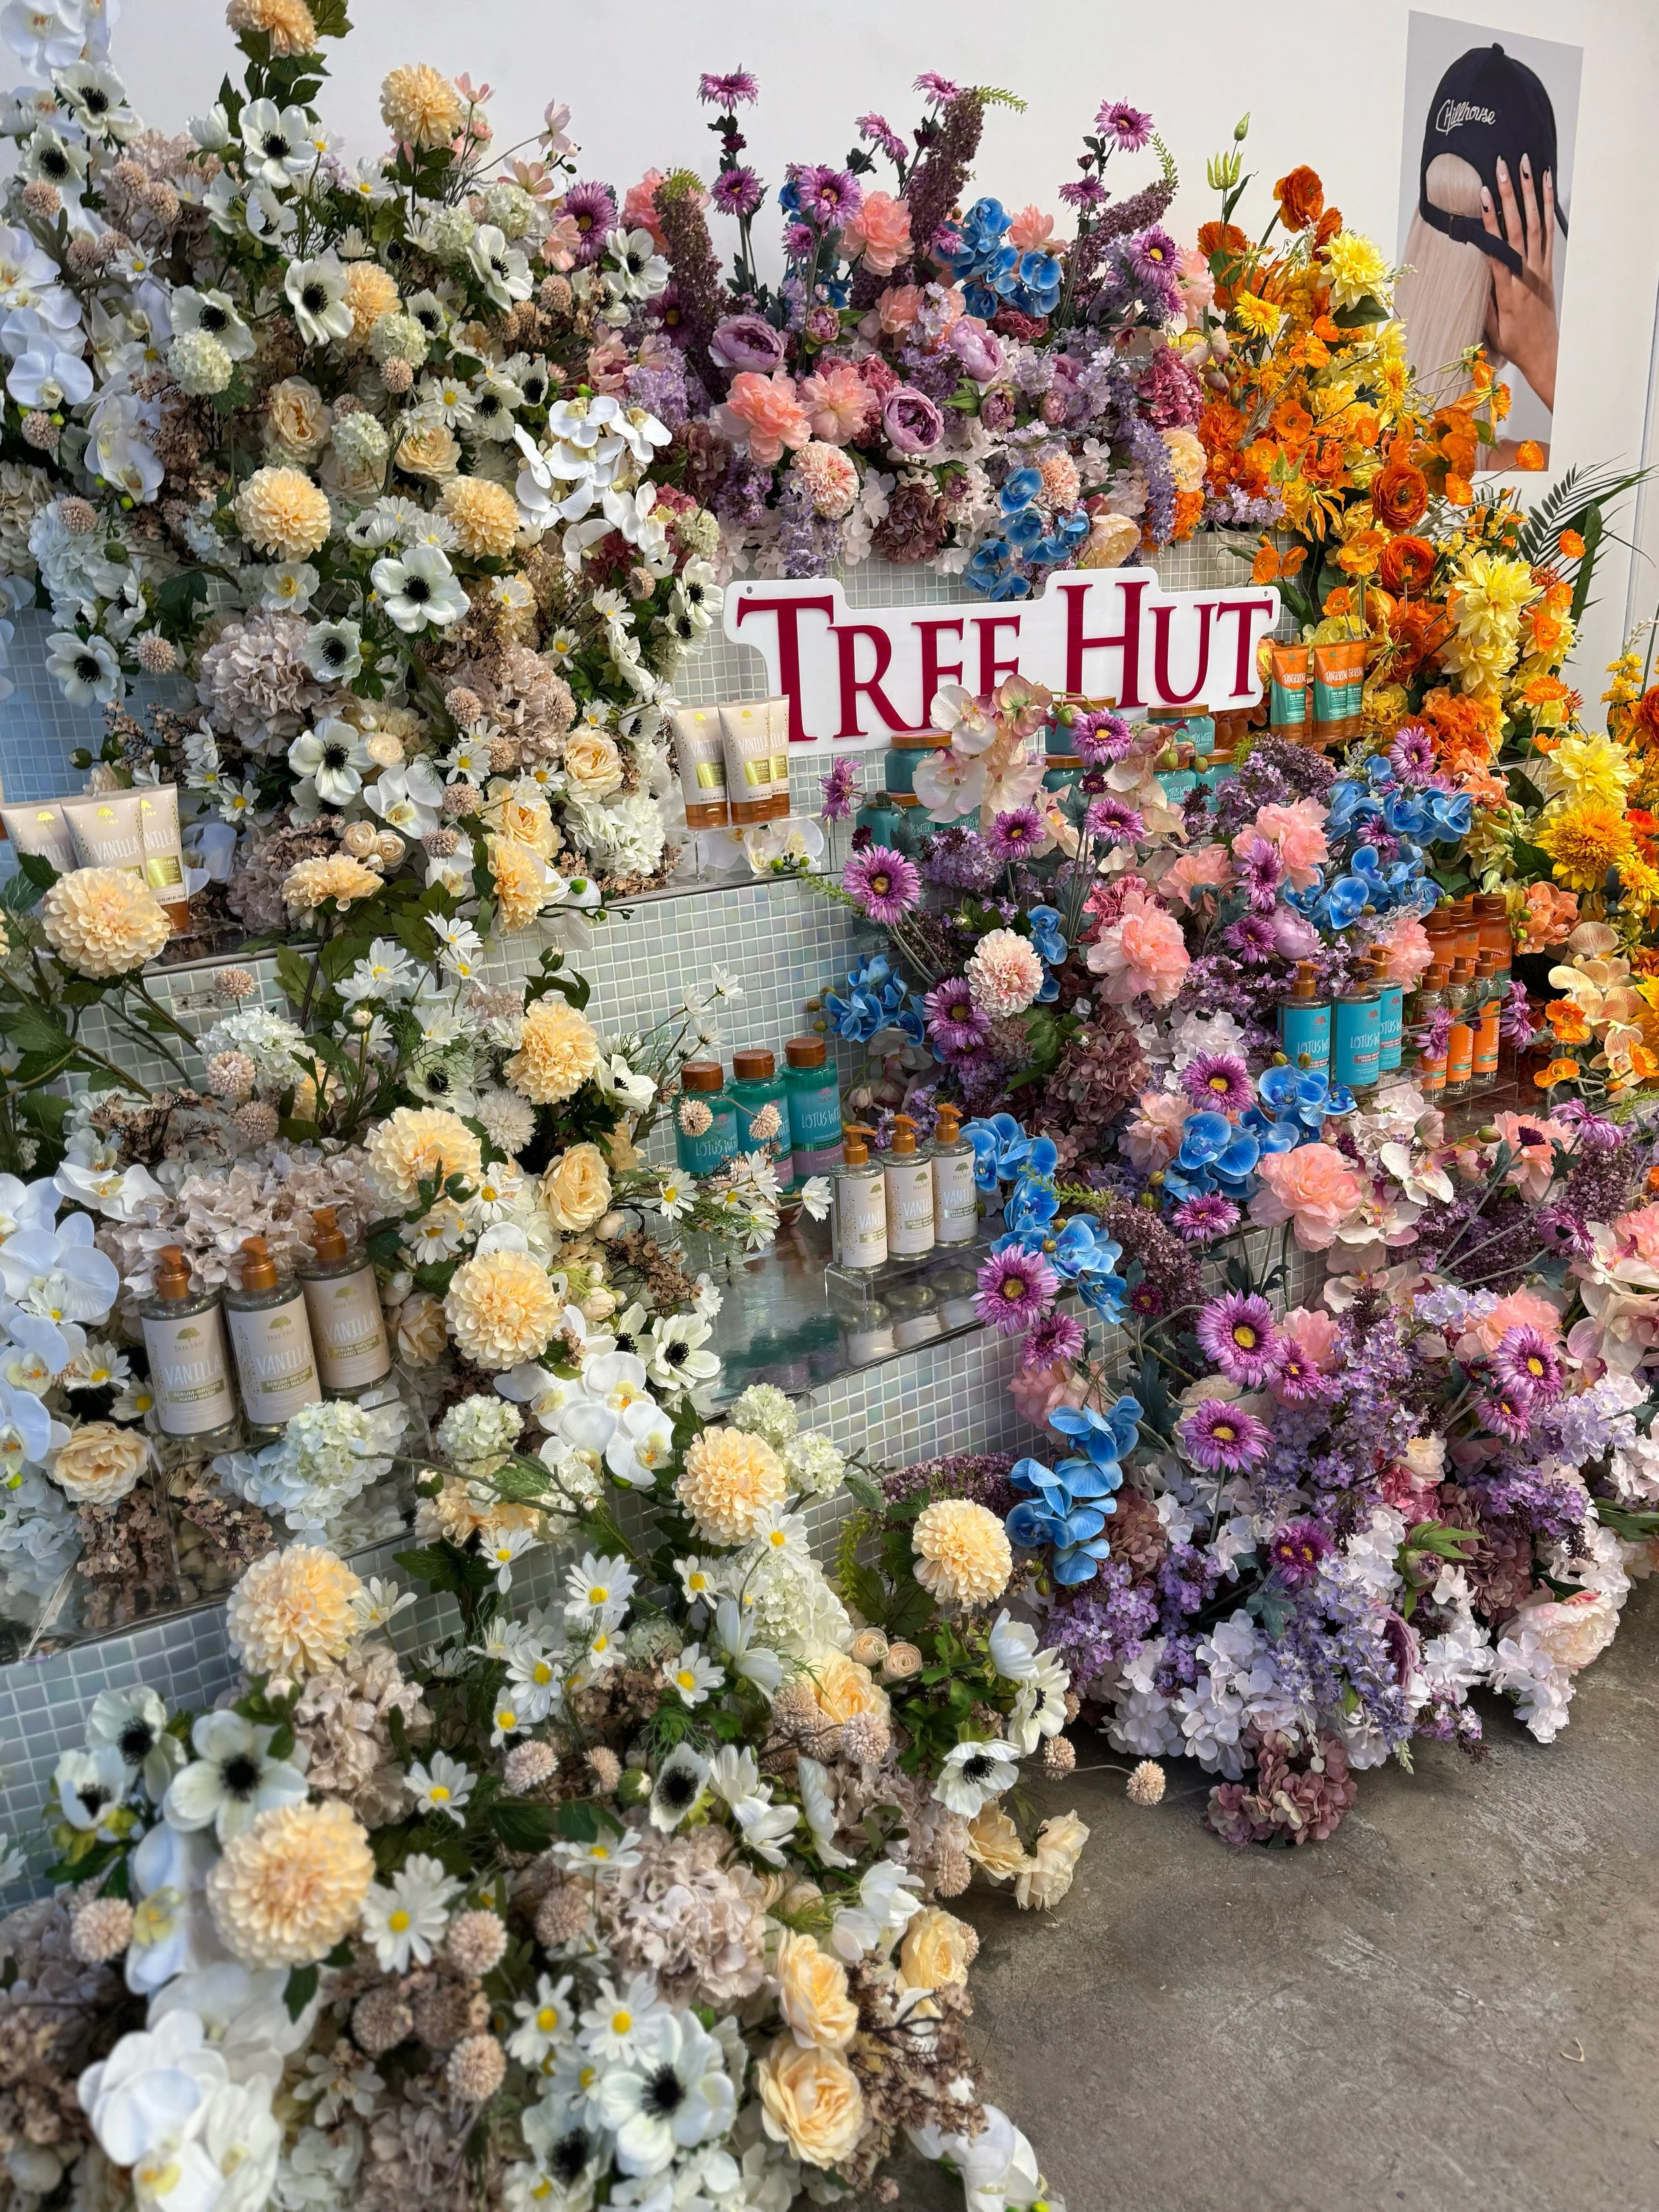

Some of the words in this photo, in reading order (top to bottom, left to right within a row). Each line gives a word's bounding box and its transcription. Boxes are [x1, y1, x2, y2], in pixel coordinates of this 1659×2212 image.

[1435, 99, 1496, 135] Chillhouse
[737, 595, 1021, 742] TREE
[1057, 581, 1273, 708] HUT
[738, 735, 768, 755] VANILLA
[93, 836, 141, 862] VANILLA
[1297, 1040, 1321, 1054] LOTUS
[1350, 1034, 1373, 1049] LOTUS
[802, 1111, 827, 1128] LOTUS
[695, 1140, 723, 1156] LOTUS
[324, 1310, 378, 1343] VANILLA
[334, 1337, 376, 1353] SERUM-INFUSED
[356, 1345, 372, 1355] WASH
[257, 1341, 311, 1376] VANILLA
[165, 1353, 223, 1386] VANILLA
[266, 1368, 310, 1387] SERUM-INFUSED
[173, 1382, 220, 1398] SERUM-INFUSED
[272, 1382, 290, 1392] HAND
[291, 1376, 307, 1386] WASH
[198, 1390, 216, 1399] WASH
